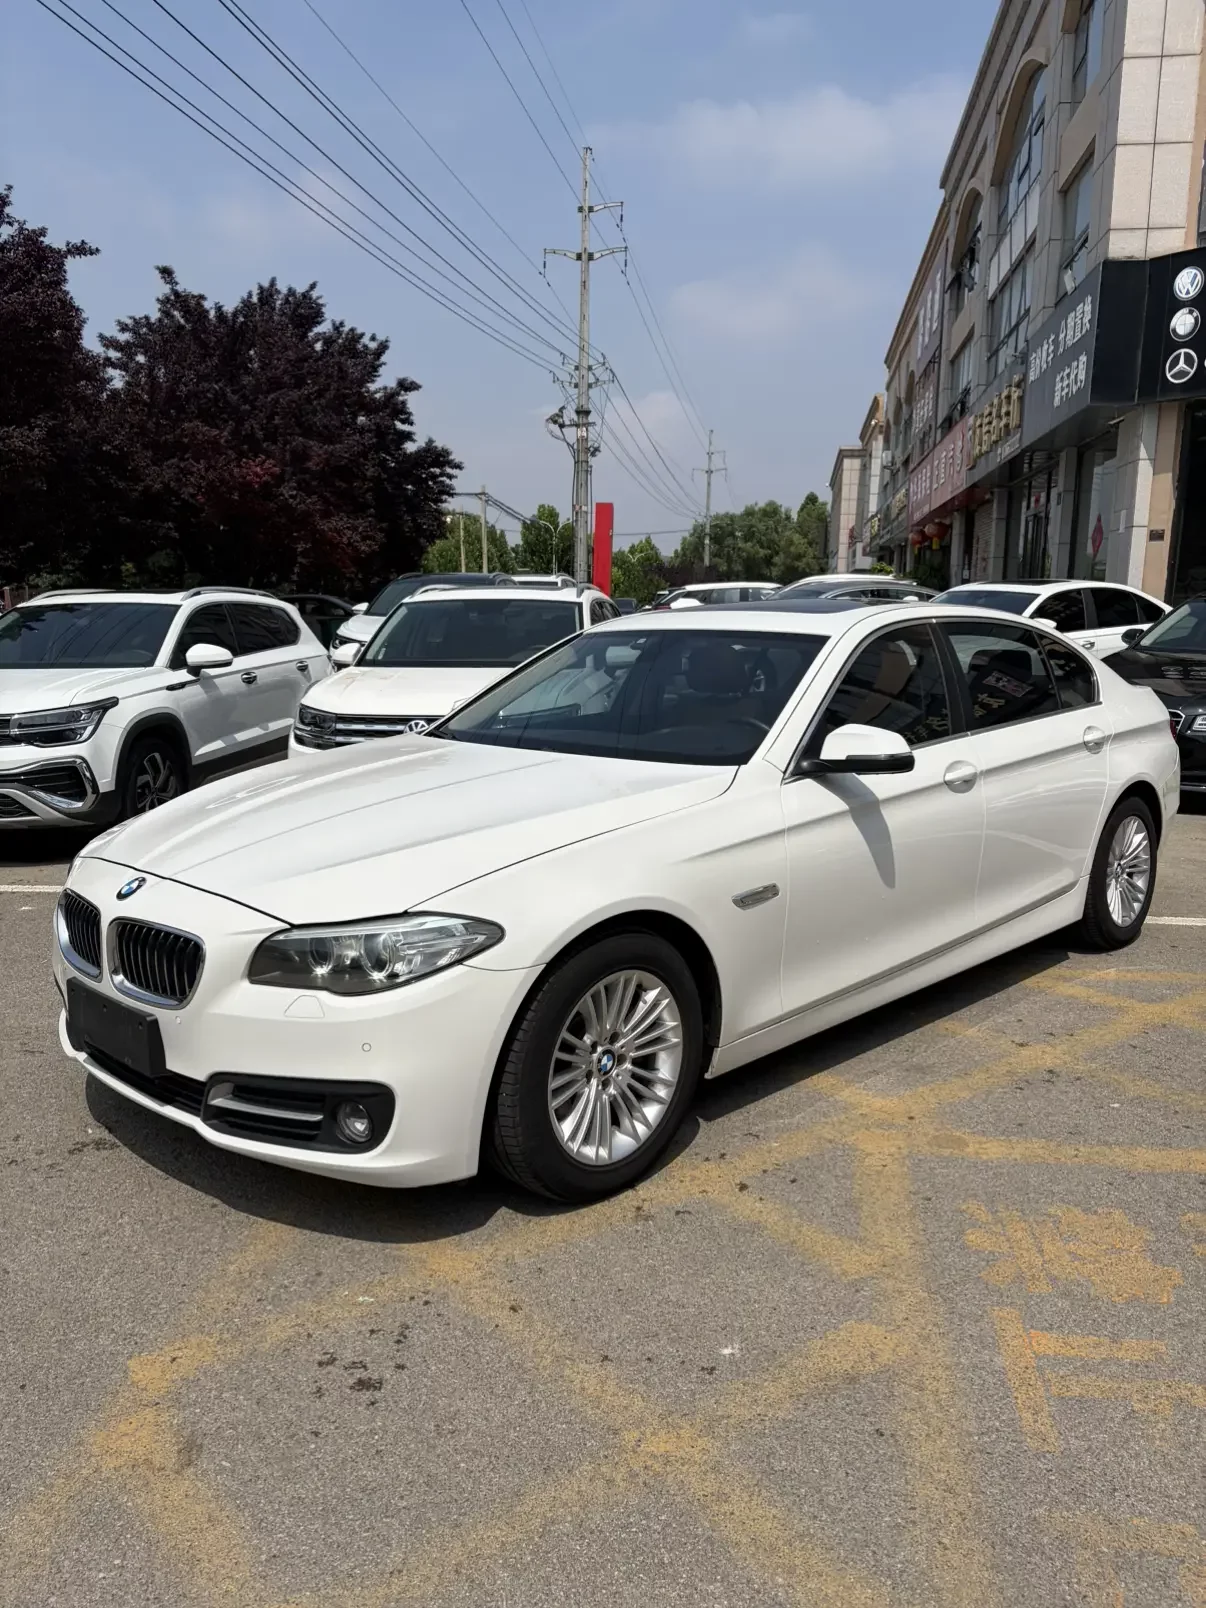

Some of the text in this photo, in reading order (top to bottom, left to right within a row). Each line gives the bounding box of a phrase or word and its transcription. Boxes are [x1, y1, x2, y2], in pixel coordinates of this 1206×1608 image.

[1029, 294, 1092, 384] 高价收车 分期置换
[1053, 351, 1088, 409] 新车代购
